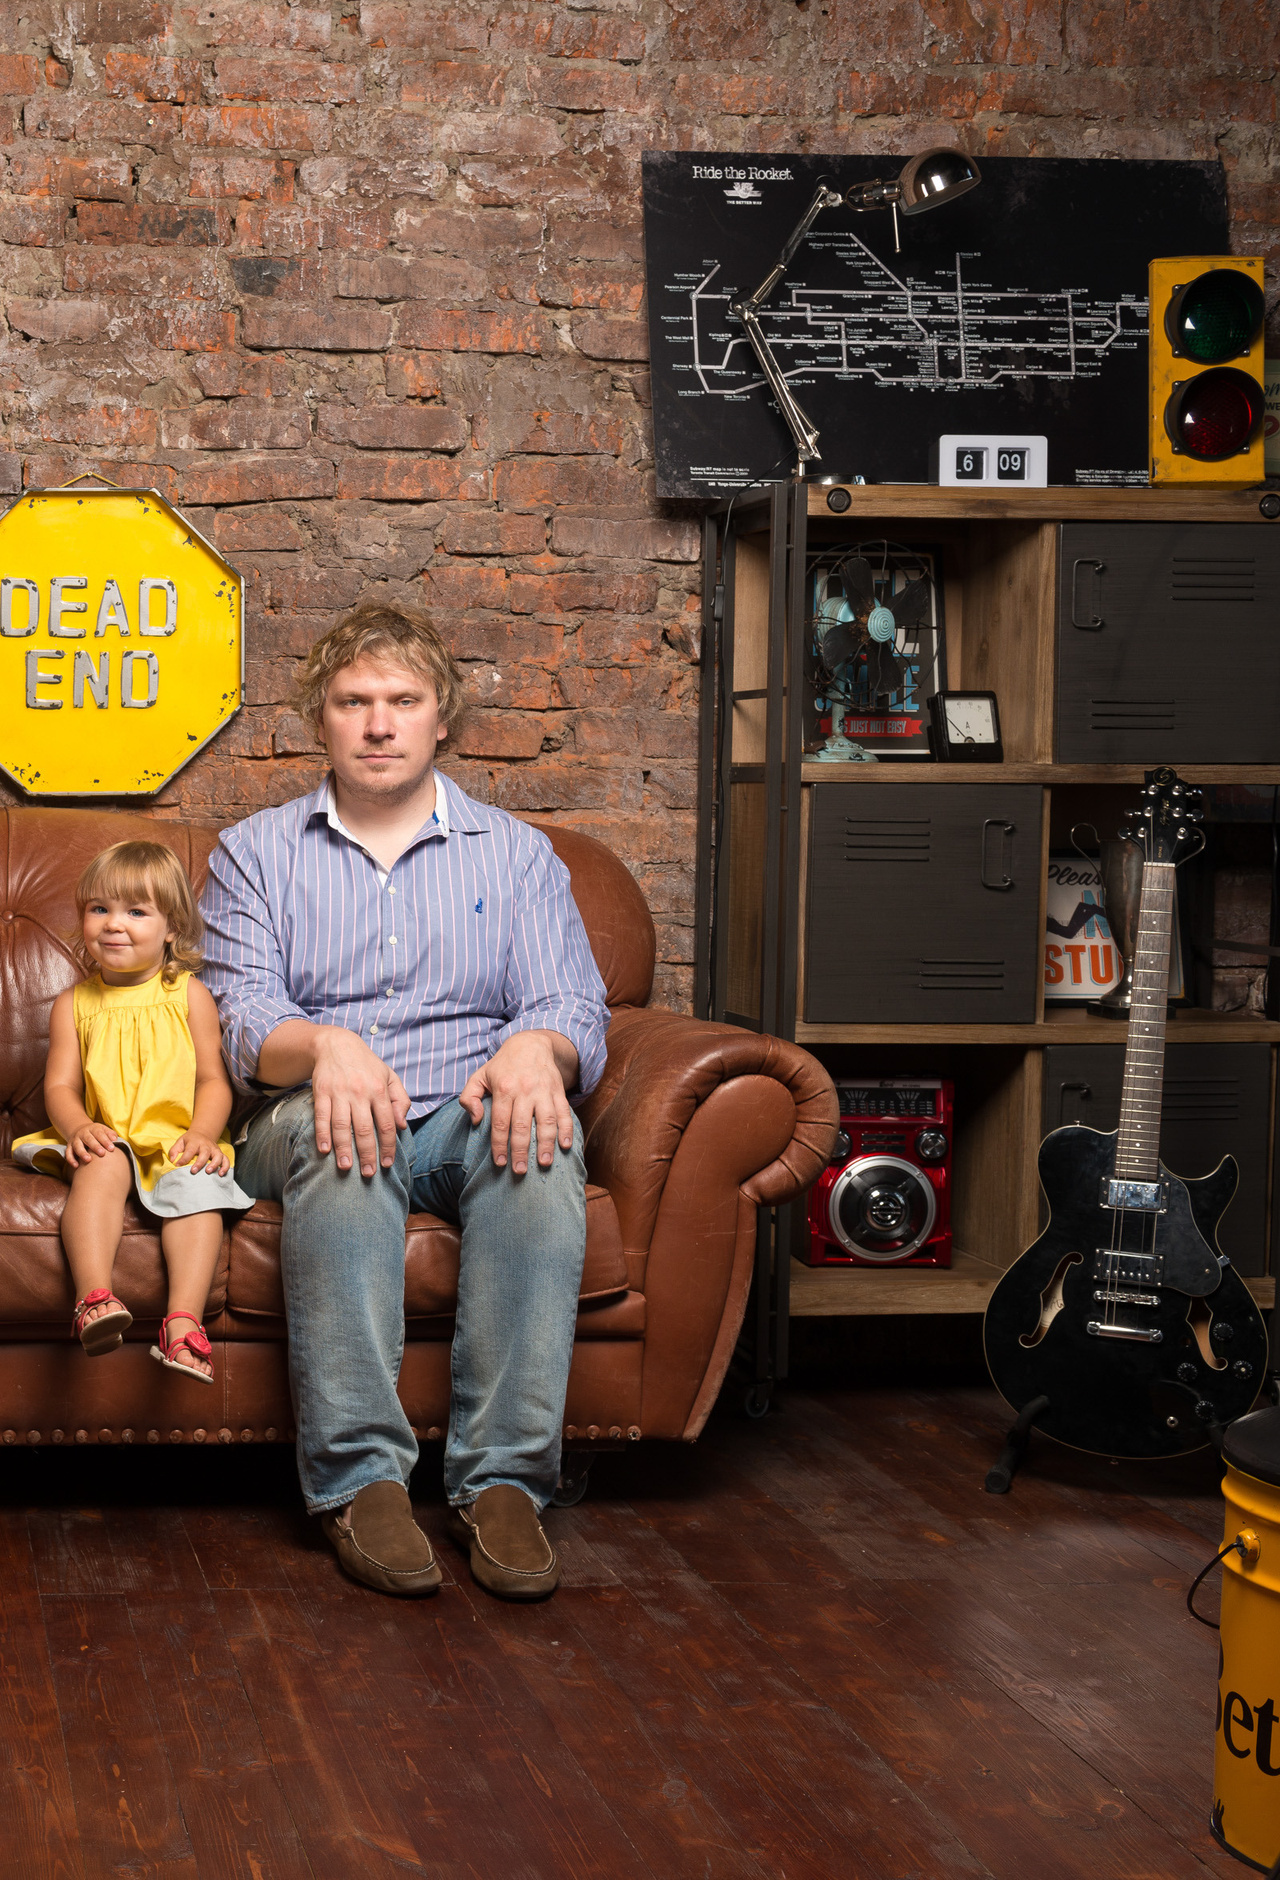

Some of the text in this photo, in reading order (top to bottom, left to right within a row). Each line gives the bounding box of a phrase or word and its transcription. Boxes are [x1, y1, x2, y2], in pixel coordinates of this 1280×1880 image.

[692, 166, 794, 180] Ride the Rocket.
[963, 453, 1021, 472] 6 09
[0, 576, 178, 638] DEAD
[25, 649, 160, 710] END
[848, 720, 868, 734] JUST
[869, 720, 886, 734] NOT
[886, 720, 907, 734] EASY
[1047, 864, 1103, 886] Pleas
[1044, 944, 1124, 985] STU
